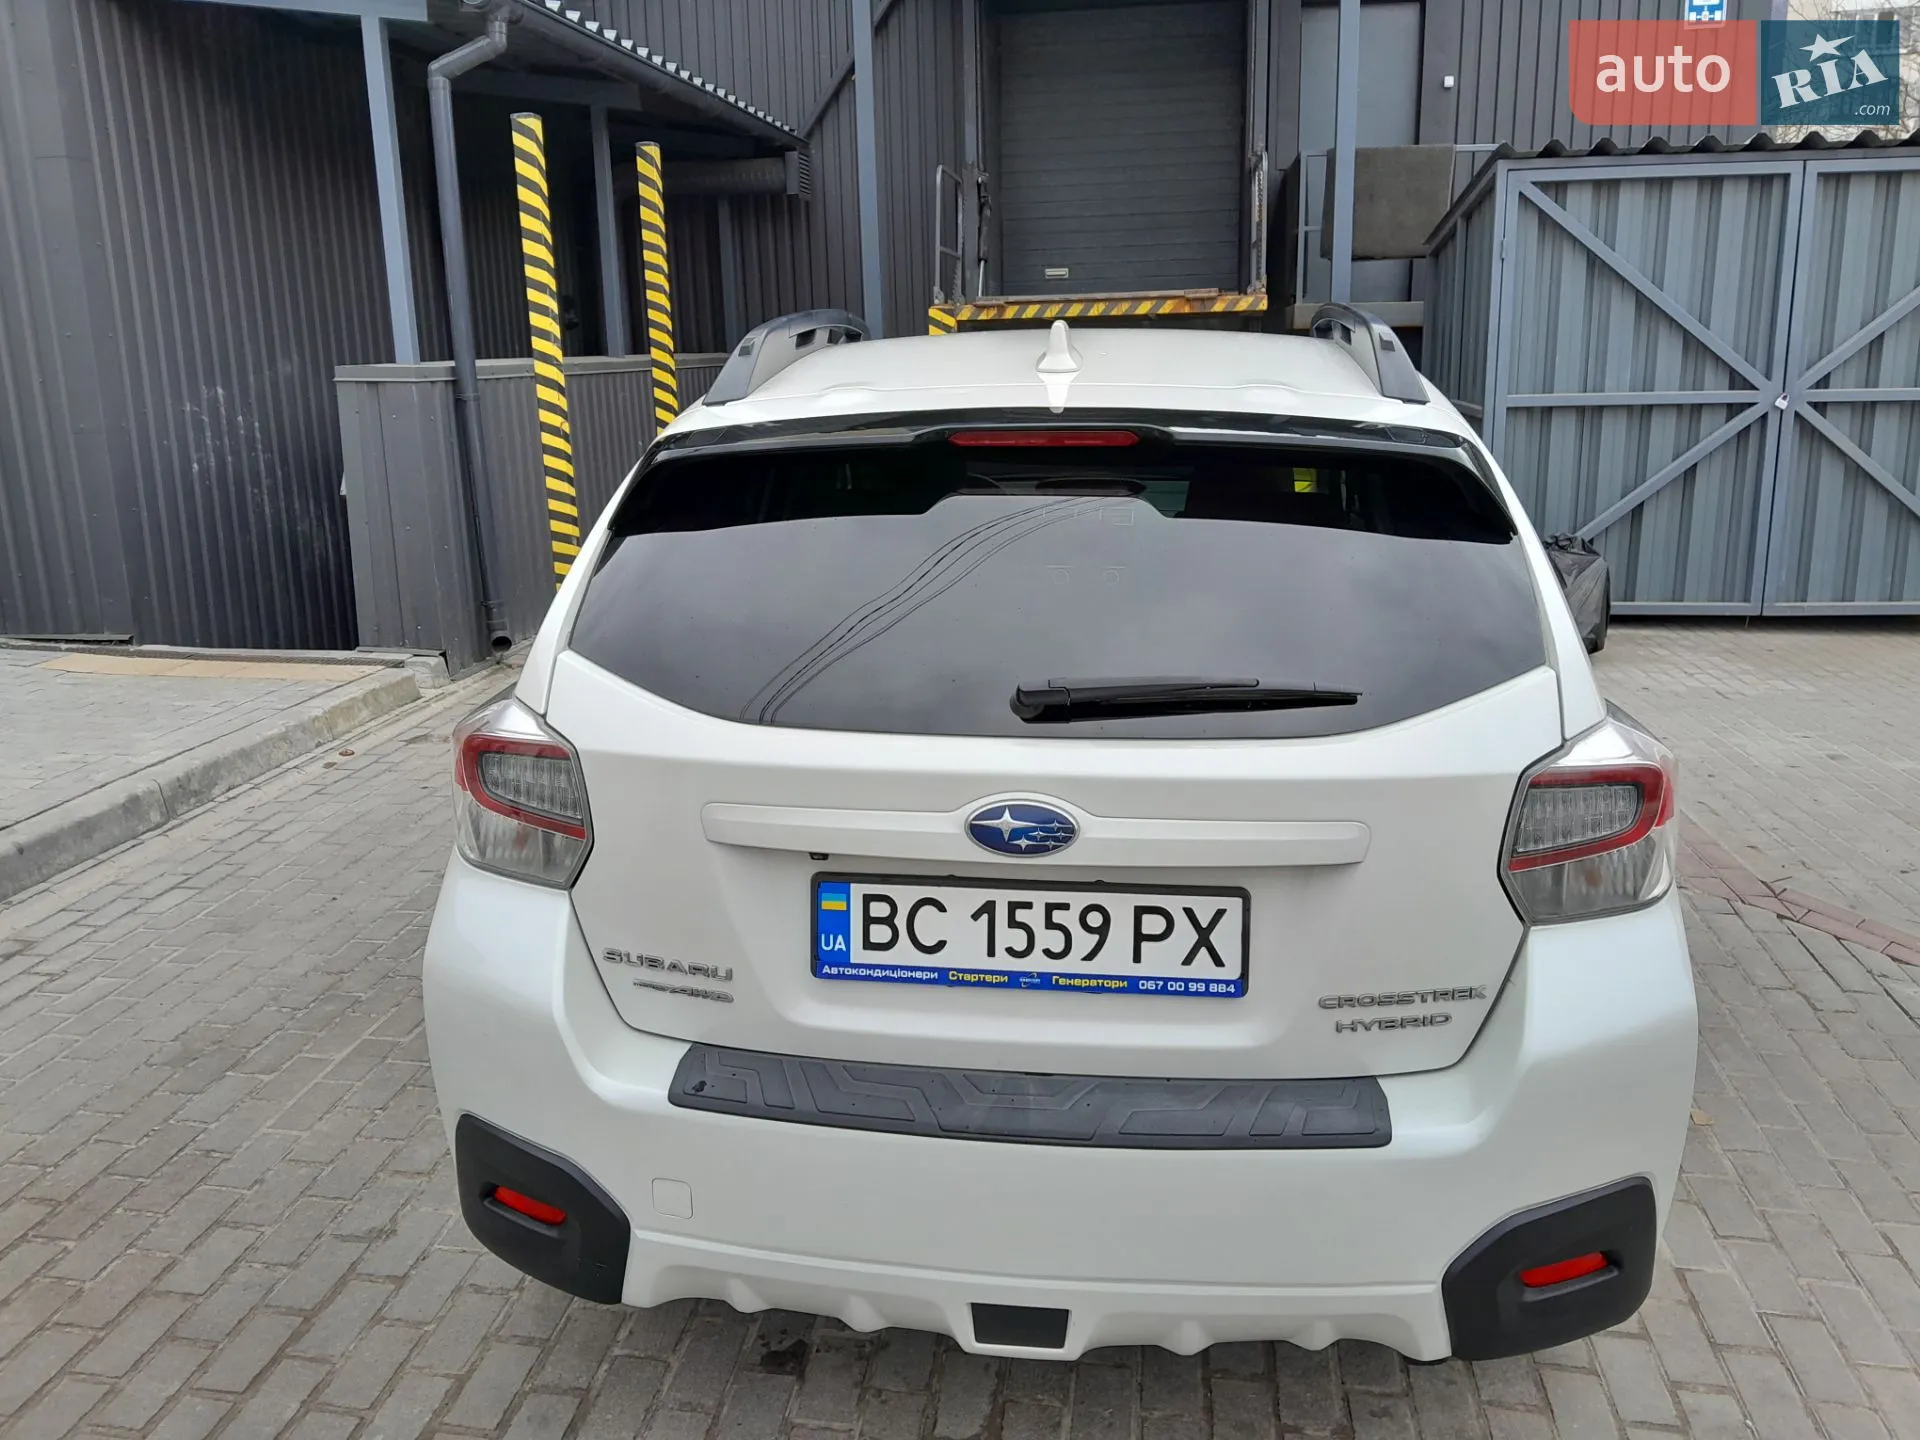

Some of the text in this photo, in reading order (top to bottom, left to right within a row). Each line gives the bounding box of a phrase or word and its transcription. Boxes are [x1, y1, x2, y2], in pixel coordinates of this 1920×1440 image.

[821, 934, 847, 952] UA
[861, 893, 1228, 967] BC 1559 PX
[602, 947, 733, 981] SUBARU
[822, 965, 939, 980] Автокондиціонери
[948, 971, 1008, 983] Стартери
[1052, 976, 1128, 990] Генератори
[1138, 980, 1163, 991] 067
[1167, 981, 1185, 991] 00
[1188, 982, 1206, 992] 99
[1209, 983, 1236, 993] 884
[669, 985, 734, 1003] AWD
[1318, 984, 1487, 1010] CROSSTREK
[1335, 1012, 1453, 1033] HYBRID
